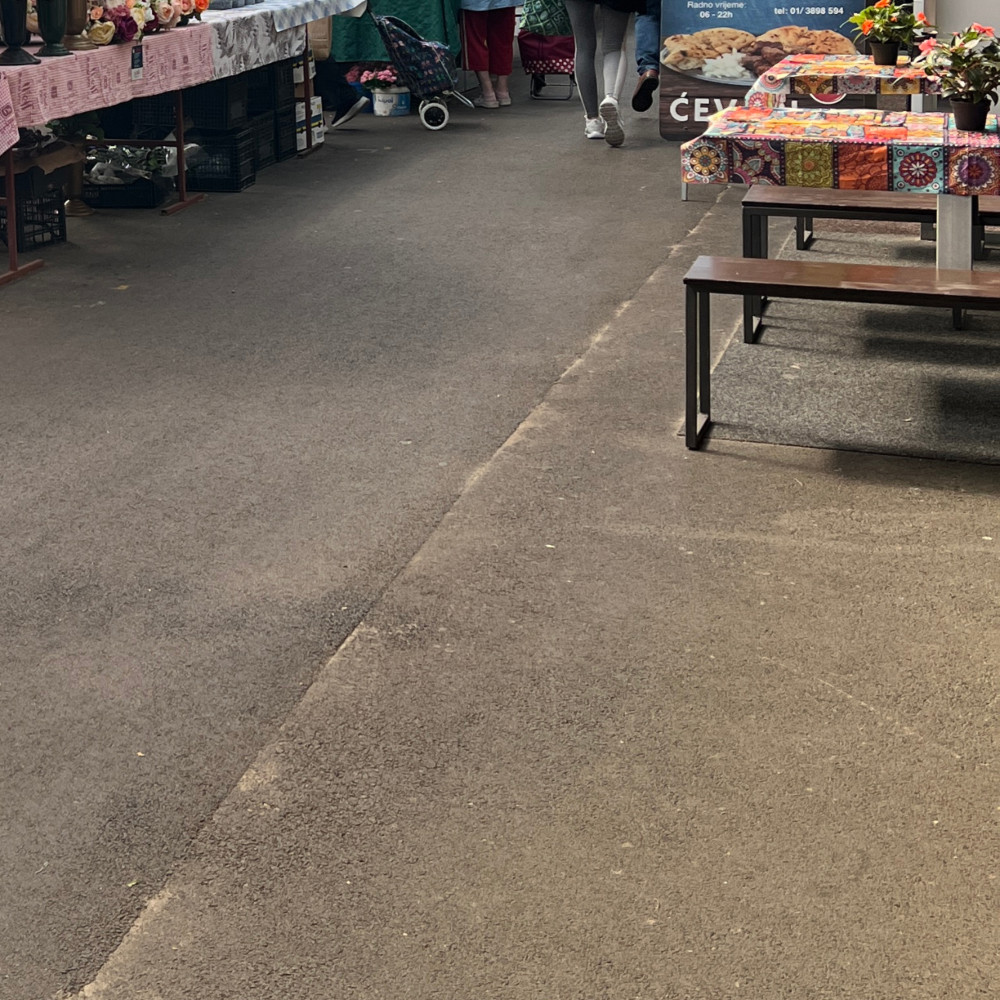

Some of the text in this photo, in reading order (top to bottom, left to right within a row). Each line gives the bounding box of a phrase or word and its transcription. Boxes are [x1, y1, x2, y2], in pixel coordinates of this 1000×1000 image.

[687, 1, 747, 10] Radno vrijeme:
[699, 11, 711, 19] 06
[717, 11, 733, 19] 22h
[774, 7, 788, 15] tel:
[828, 7, 844, 15] 594
